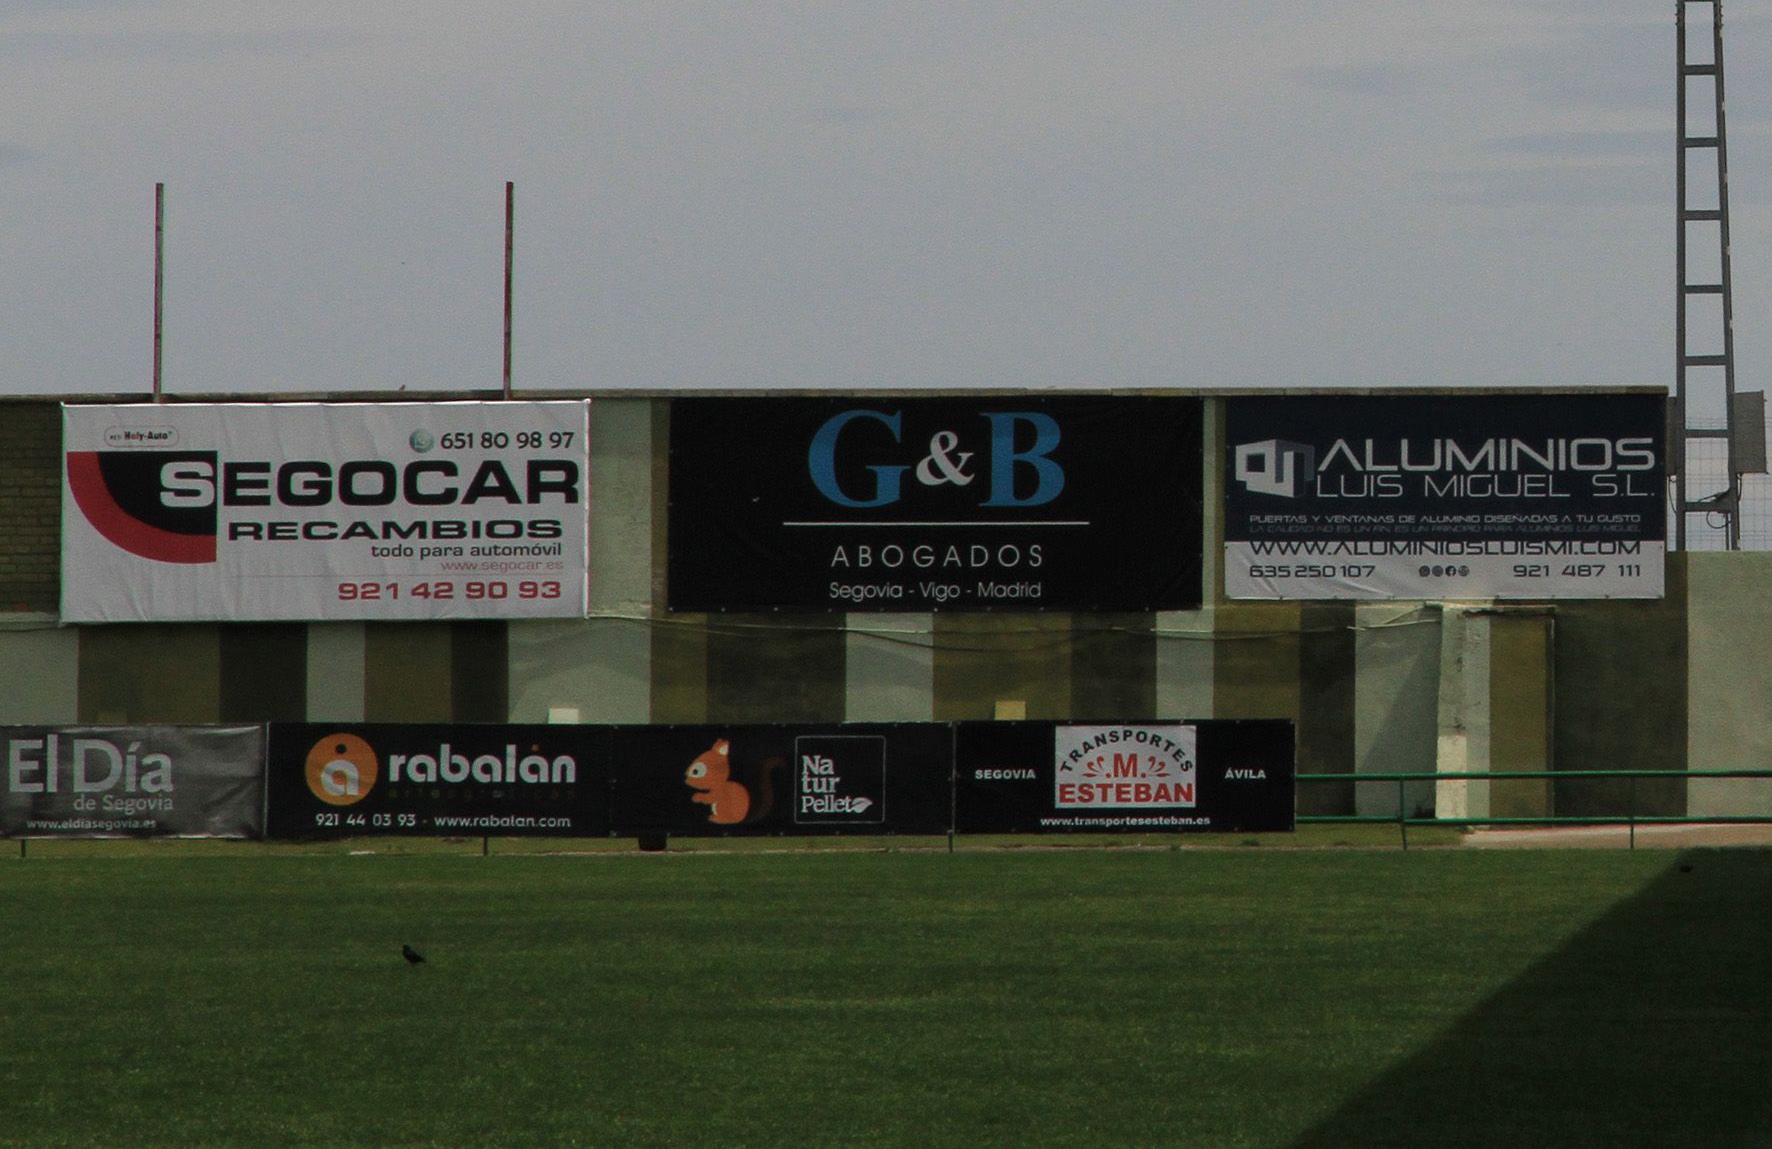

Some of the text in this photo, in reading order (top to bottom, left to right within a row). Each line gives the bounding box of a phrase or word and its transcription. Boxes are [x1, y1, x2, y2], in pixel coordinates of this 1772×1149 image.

[440, 431, 575, 450] 651 80 98 97
[807, 409, 1067, 509] G&B
[1317, 437, 1656, 472] ALUMINIOS
[158, 457, 581, 508] SEGOCAR
[1316, 473, 1656, 499] LUIS MIGUEL S.L.
[1249, 514, 1308, 524] PUERTAS
[1311, 514, 1325, 524] Y
[1325, 514, 1395, 524] VENTANAS
[1398, 514, 1416, 524] DE
[1420, 514, 1481, 524] ALUMINIO
[1560, 514, 1573, 523] A
[1576, 514, 1593, 523] TU
[1597, 514, 1642, 523] GUSTO
[227, 519, 563, 542] RECAMBIOS
[371, 542, 563, 561] todo para automóvil
[830, 544, 1044, 569] ABOGADOS
[1249, 541, 1641, 556] WWW.ALUMINIOSLUISMI.COM
[440, 559, 565, 574] www.segocar.es
[1249, 565, 1376, 578] 635 250 107
[1512, 564, 1641, 578] 921 487 111
[338, 581, 562, 601] 921 42 90 93
[829, 580, 1042, 602] Segovia Vigo Madrid
[1059, 728, 1194, 774] TRANSPORTES
[8, 733, 175, 793] El Día
[801, 755, 835, 775] Na
[801, 772, 841, 794] tur
[974, 768, 1037, 781] SEGOVIA
[1224, 767, 1267, 780] ÁVILA
[1058, 782, 1194, 804] ESTEBAN
[73, 793, 174, 816] de Segovia
[800, 794, 853, 814] Pellet
[314, 813, 340, 828] 921
[345, 813, 366, 827] 44
[372, 813, 392, 828] 03
[397, 813, 417, 828] 93
[1040, 815, 1211, 828] www.transportesesteban.es
